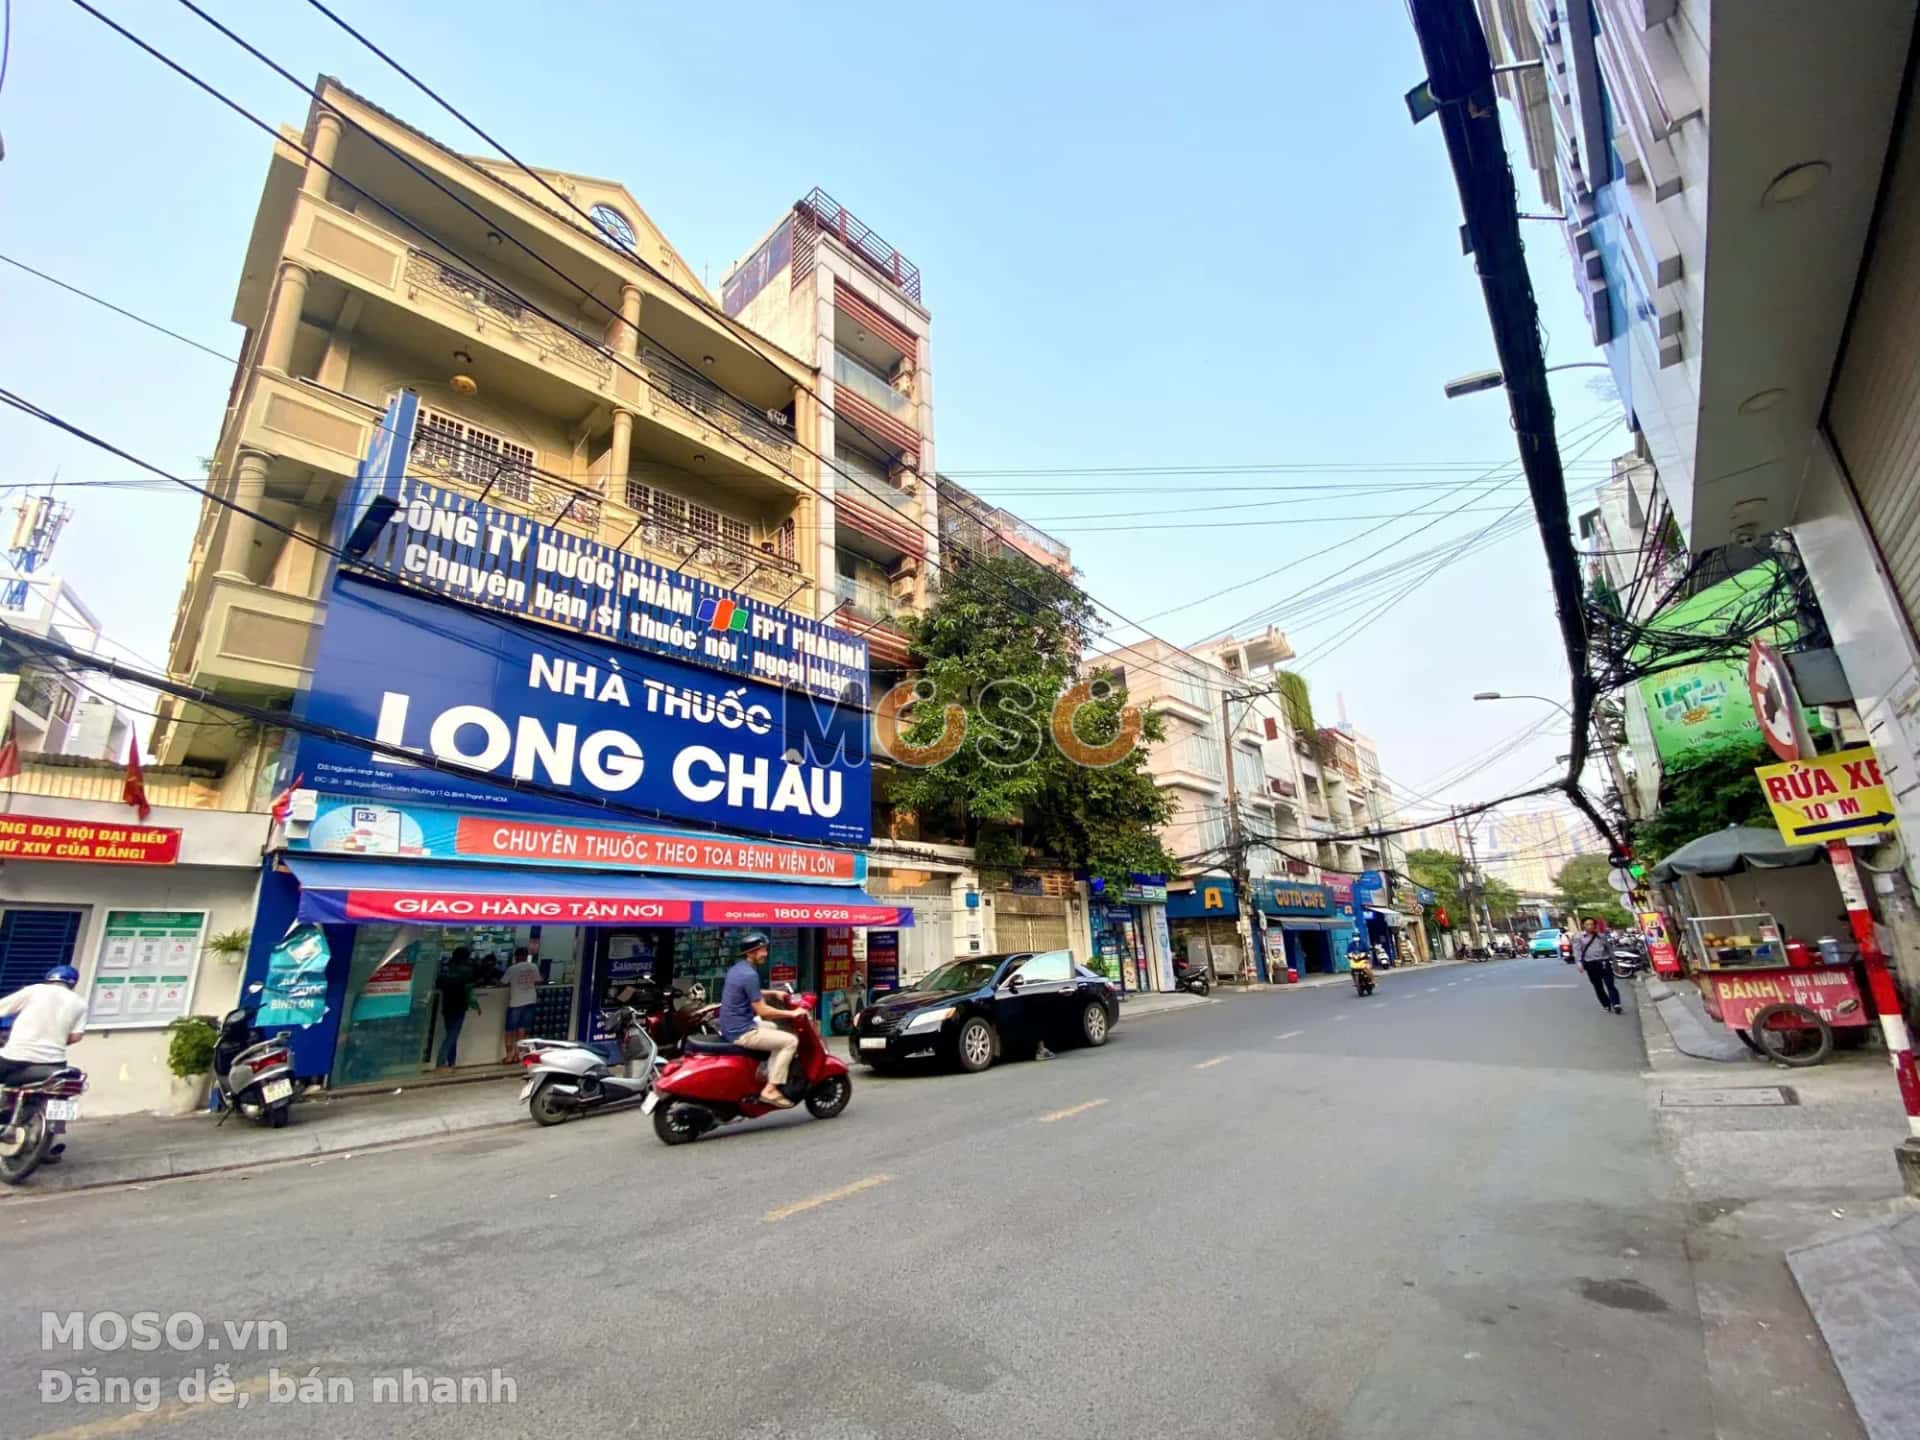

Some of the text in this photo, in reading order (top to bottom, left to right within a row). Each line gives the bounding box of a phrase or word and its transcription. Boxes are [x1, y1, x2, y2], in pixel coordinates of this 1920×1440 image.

[487, 525, 529, 562] TY
[536, 541, 616, 591] DƯỢC
[622, 568, 694, 617] PHẨM
[403, 543, 526, 603] Chuyên
[535, 581, 588, 621] bán
[630, 611, 697, 651] thuốc
[752, 612, 866, 671] FPT PHARMA
[528, 652, 773, 736] NHÀ THUỐC
[371, 690, 843, 819] LONG CHÂU
[1765, 758, 1885, 804] RỬA XE
[0, 820, 27, 835] NG
[31, 824, 62, 840] ĐẠI
[66, 825, 95, 841] HỘI
[99, 829, 127, 843] ĐẠI
[1802, 796, 1861, 821] 10 M
[22, 842, 52, 854] XIV
[56, 841, 91, 857] CỦA
[95, 842, 146, 860] ĐẢNG!
[492, 827, 836, 875] CHUYÊN THUỐC THEO TOA BỆNH VIỆN LỚN
[393, 898, 664, 920] GIAO HÀNG TẬN NƠI
[774, 907, 810, 920] 1800
[813, 908, 849, 920] 6928
[1204, 887, 1224, 910] A
